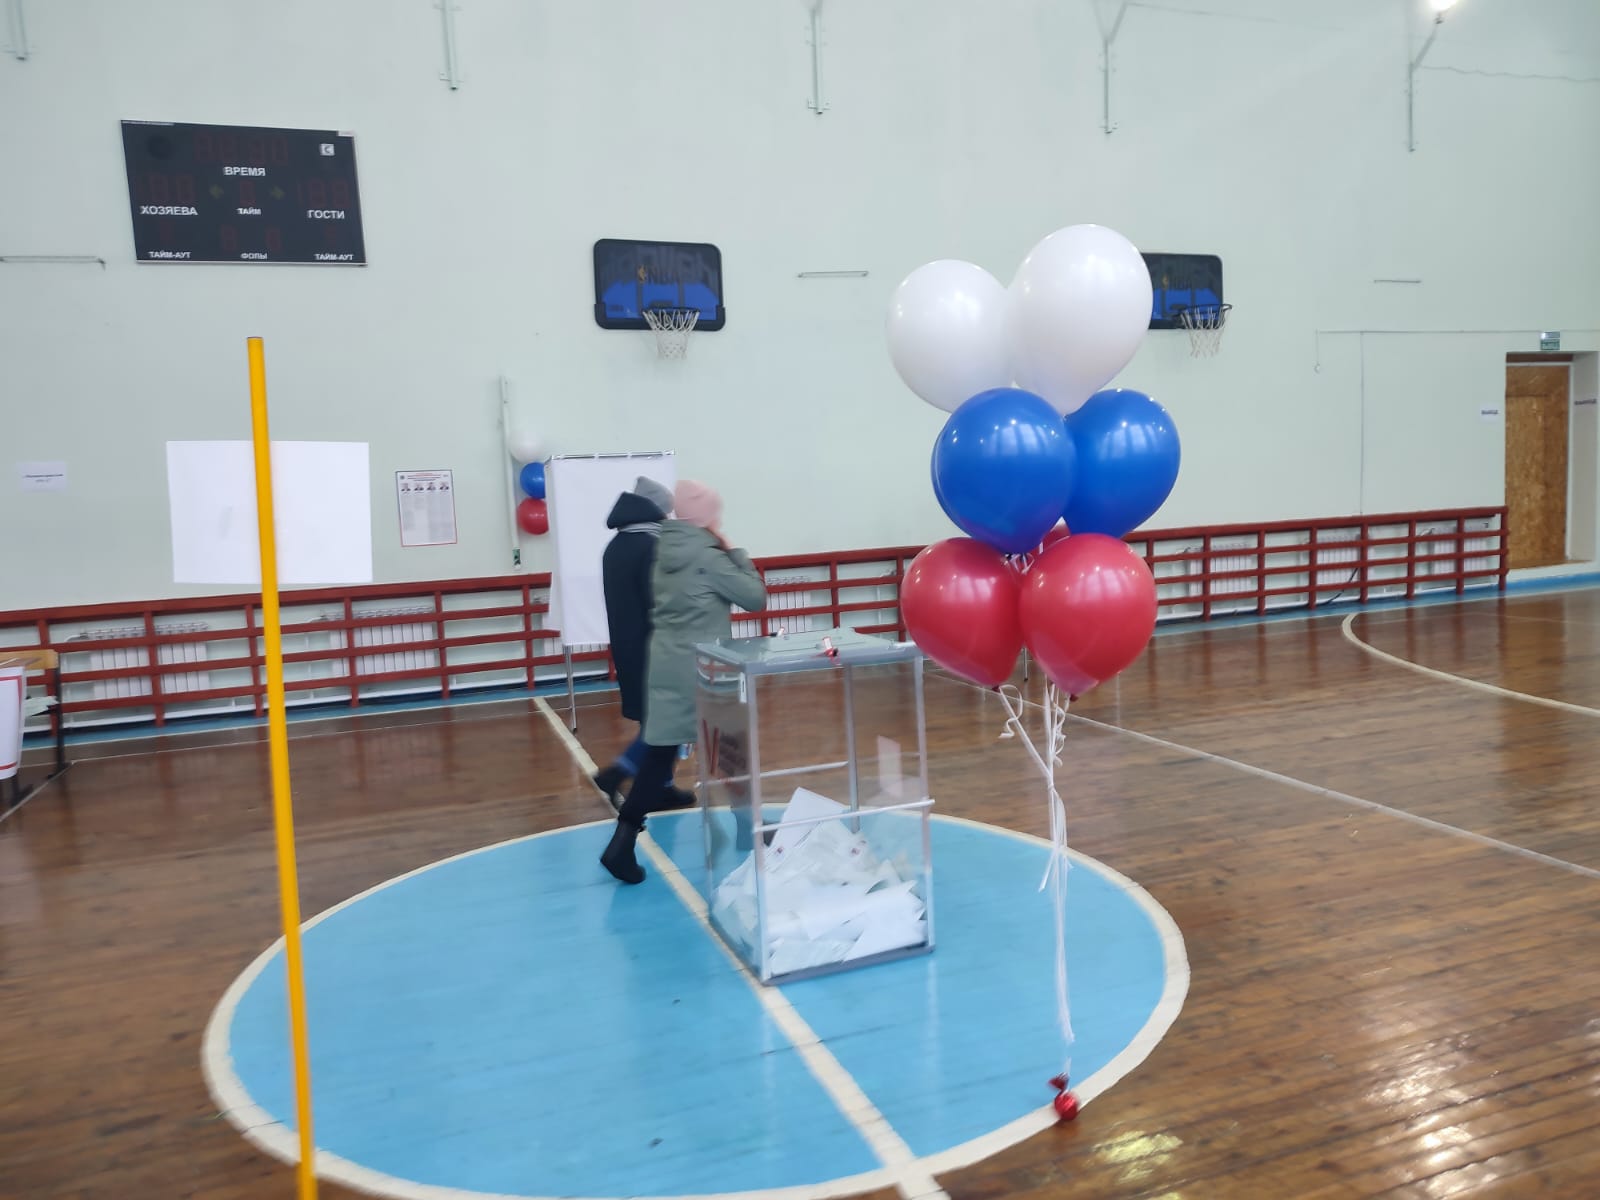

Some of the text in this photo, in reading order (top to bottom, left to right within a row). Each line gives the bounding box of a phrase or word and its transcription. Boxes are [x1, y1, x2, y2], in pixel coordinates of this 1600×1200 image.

[224, 166, 266, 177] ВРЕМЯ
[141, 205, 198, 216] ХОЗЯЕВА
[237, 207, 261, 215] ТАЙМ
[308, 209, 345, 219] ГОСТИ
[149, 250, 190, 258] ТАЙМ-АУТ
